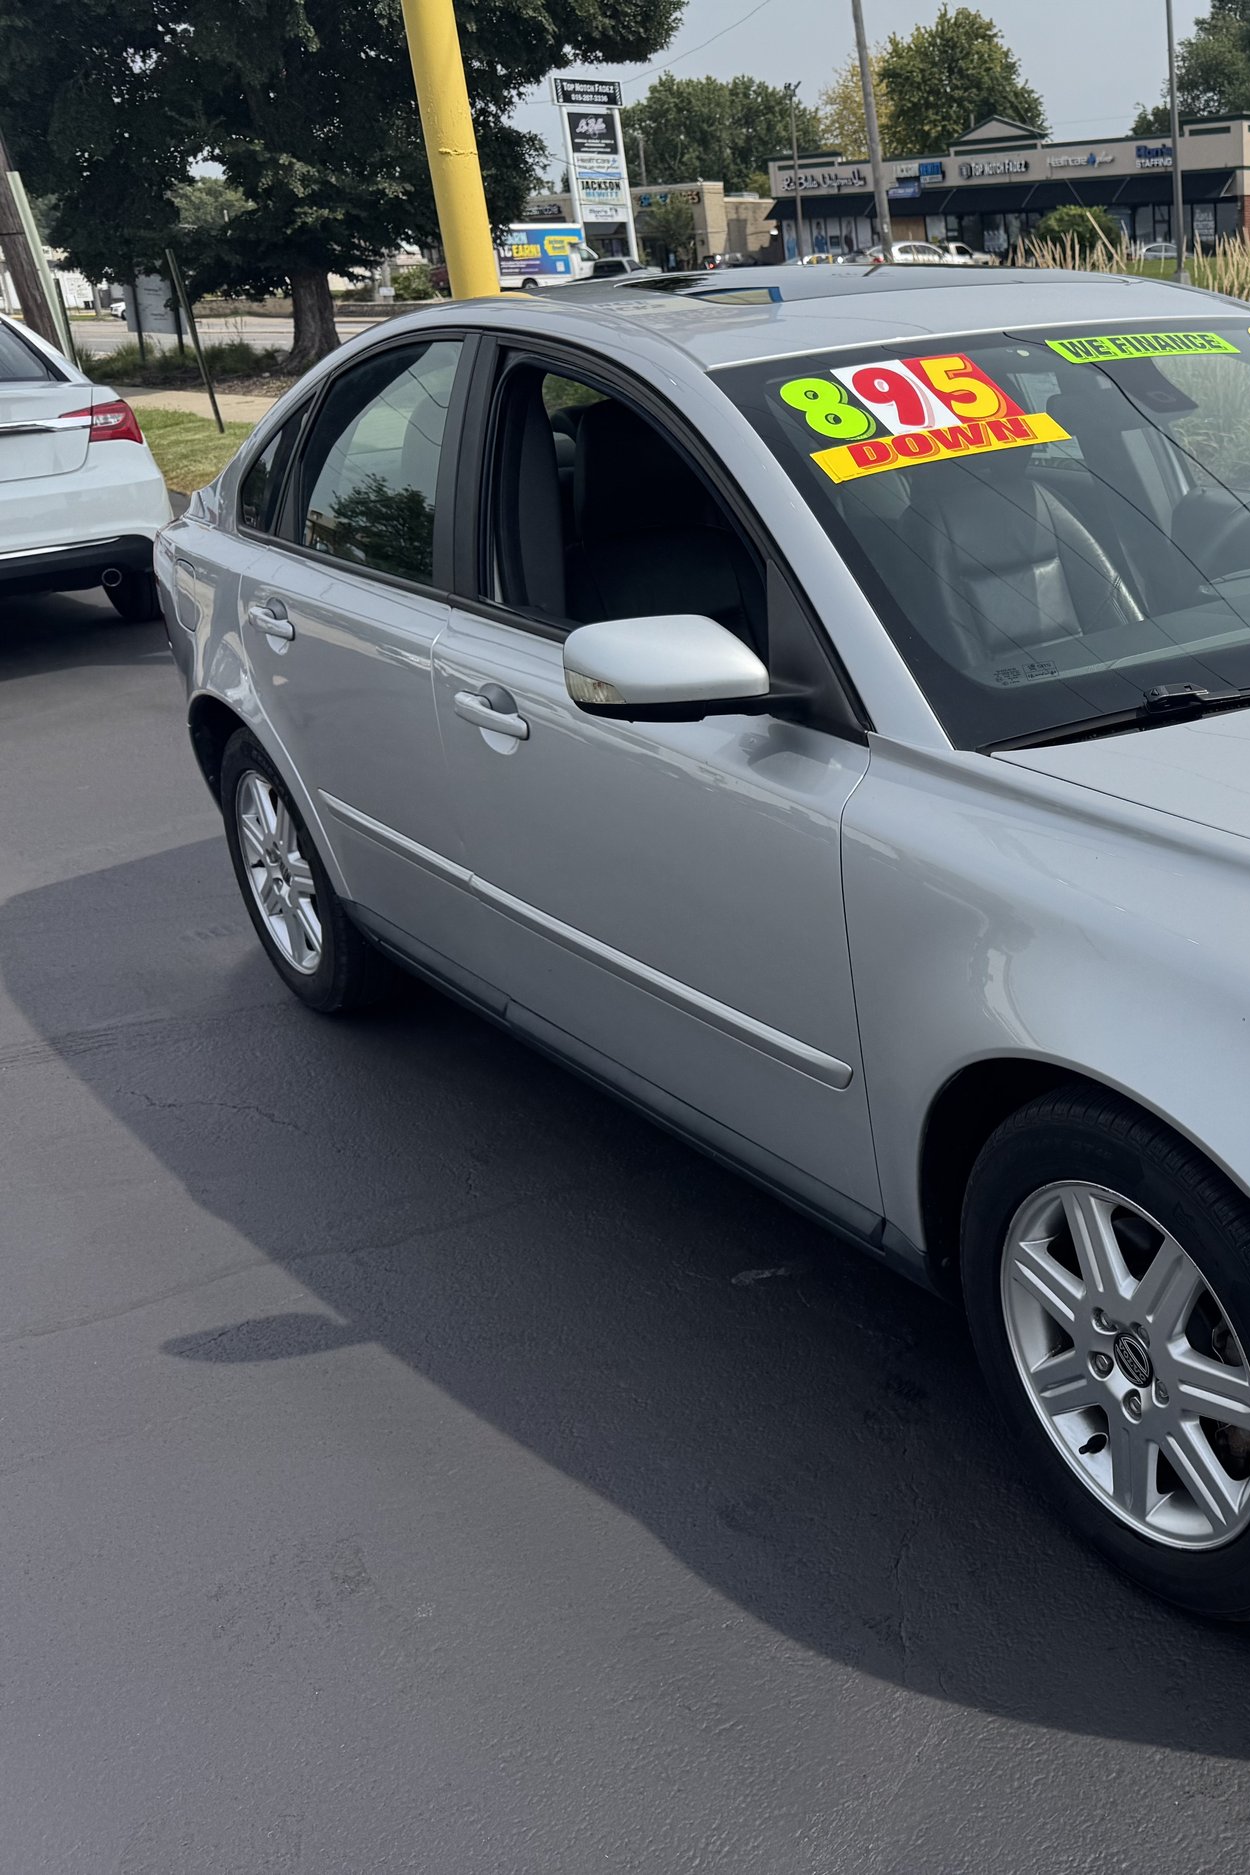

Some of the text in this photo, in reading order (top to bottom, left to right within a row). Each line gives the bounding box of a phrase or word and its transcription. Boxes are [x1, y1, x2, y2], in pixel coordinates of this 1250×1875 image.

[971, 163, 983, 176] TOP
[984, 161, 1004, 175] NOTCH
[1136, 157, 1173, 169] STAFFING
[581, 180, 621, 191] JACKSON
[1058, 333, 1228, 360] WE FINANCE
[780, 356, 1007, 440] 895
[847, 418, 1038, 469] DOWN
[1118, 1340, 1147, 1382] VOLVO
